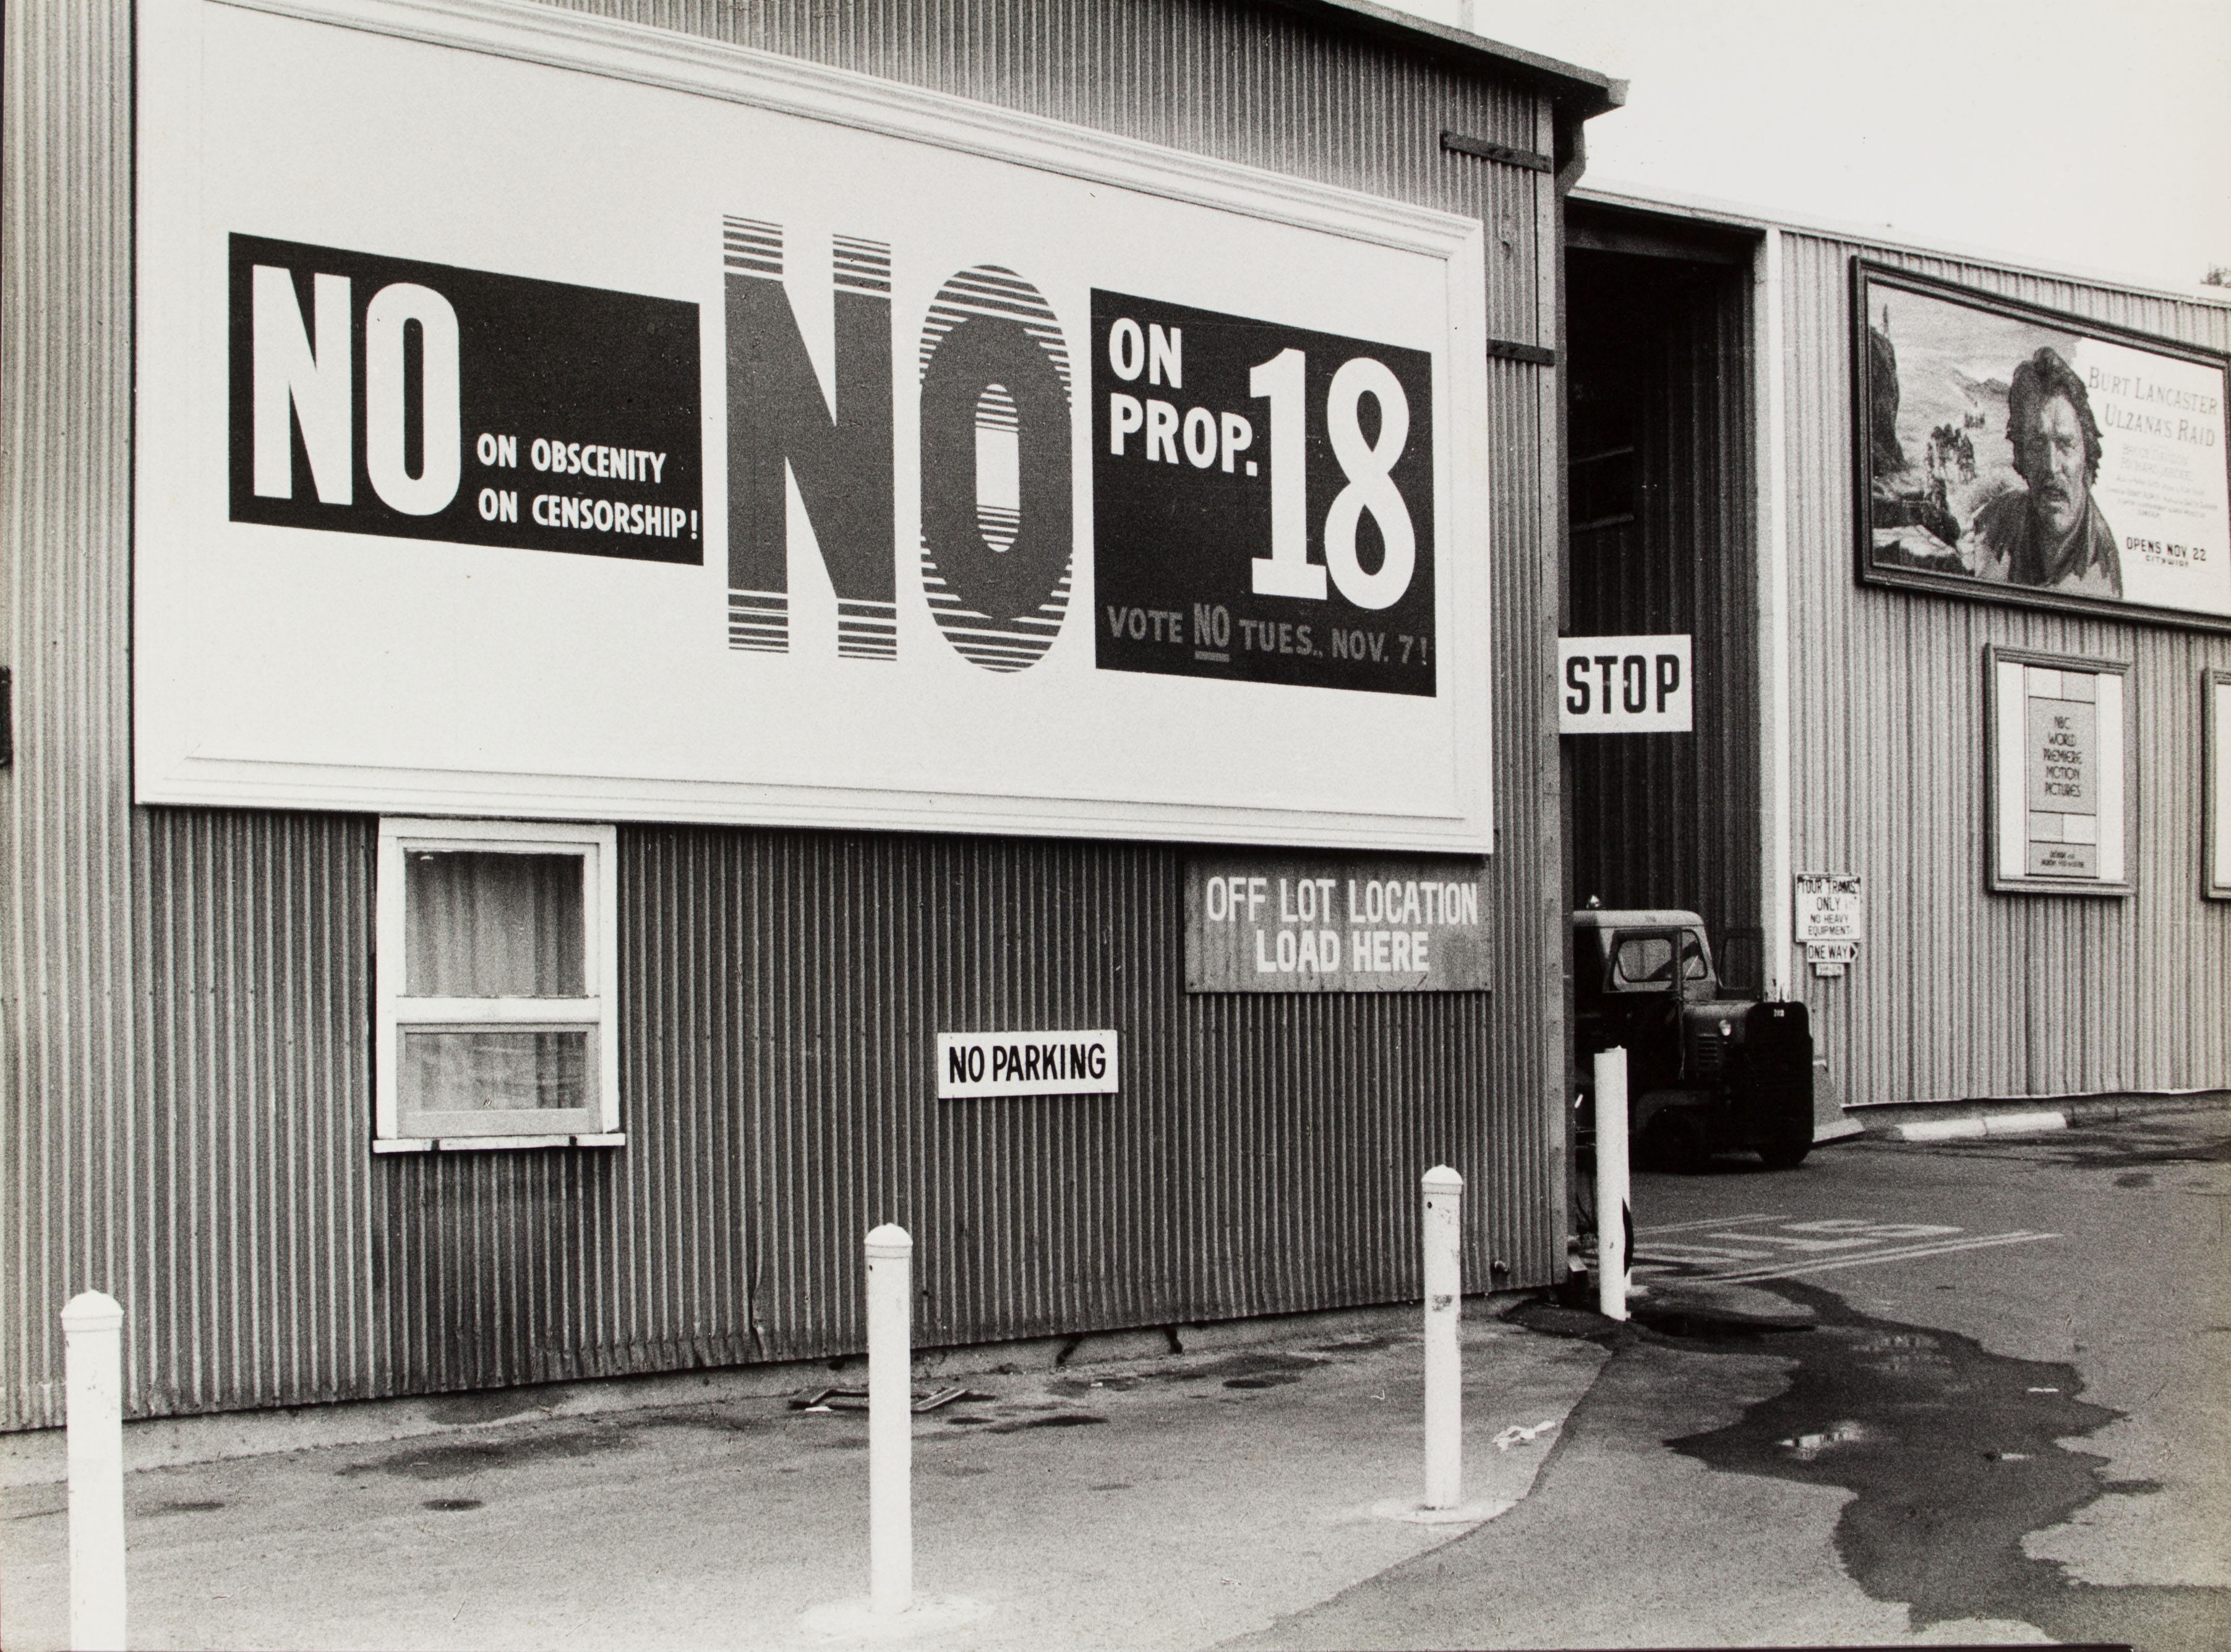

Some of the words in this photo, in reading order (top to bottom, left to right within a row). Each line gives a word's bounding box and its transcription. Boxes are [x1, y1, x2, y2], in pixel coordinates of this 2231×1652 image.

[1108, 317, 1182, 388] ON
[252, 264, 461, 516] NO
[2088, 366, 2131, 396] BURT
[2135, 376, 2218, 416] LANCASTER
[723, 214, 1073, 674] NO
[2178, 419, 2215, 447] RAID
[476, 433, 517, 468] ON
[530, 439, 667, 484] OBSCENITY
[1110, 393, 1258, 477] PROP.
[1249, 347, 1416, 610] 18
[478, 489, 518, 523] ON
[531, 495, 698, 540] CENSORSHIP!
[2126, 536, 2162, 554] OPENS
[2167, 543, 2188, 557] NOV
[2193, 547, 2207, 561] 22
[1107, 605, 1183, 644] VOTE
[1194, 602, 1230, 649] NO
[1331, 628, 1389, 664] NOV.
[1566, 654, 1680, 715] STOP
[1207, 877, 1267, 922] OFF
[1280, 878, 1336, 923] LOT
[1349, 879, 1478, 925] LOCATION
[1810, 914, 1821, 923] NO
[1824, 914, 1848, 924] HEAVY
[1817, 897, 1839, 911] ONLY
[1257, 930, 1341, 973] LOAD
[1353, 931, 1429, 972] HERE
[1808, 926, 1850, 936] EQUIPMENT
[1808, 945, 1825, 959] ONE
[1828, 946, 1848, 959] WAY
[949, 1045, 985, 1084] NO
[993, 1043, 1106, 1081] PARKING
